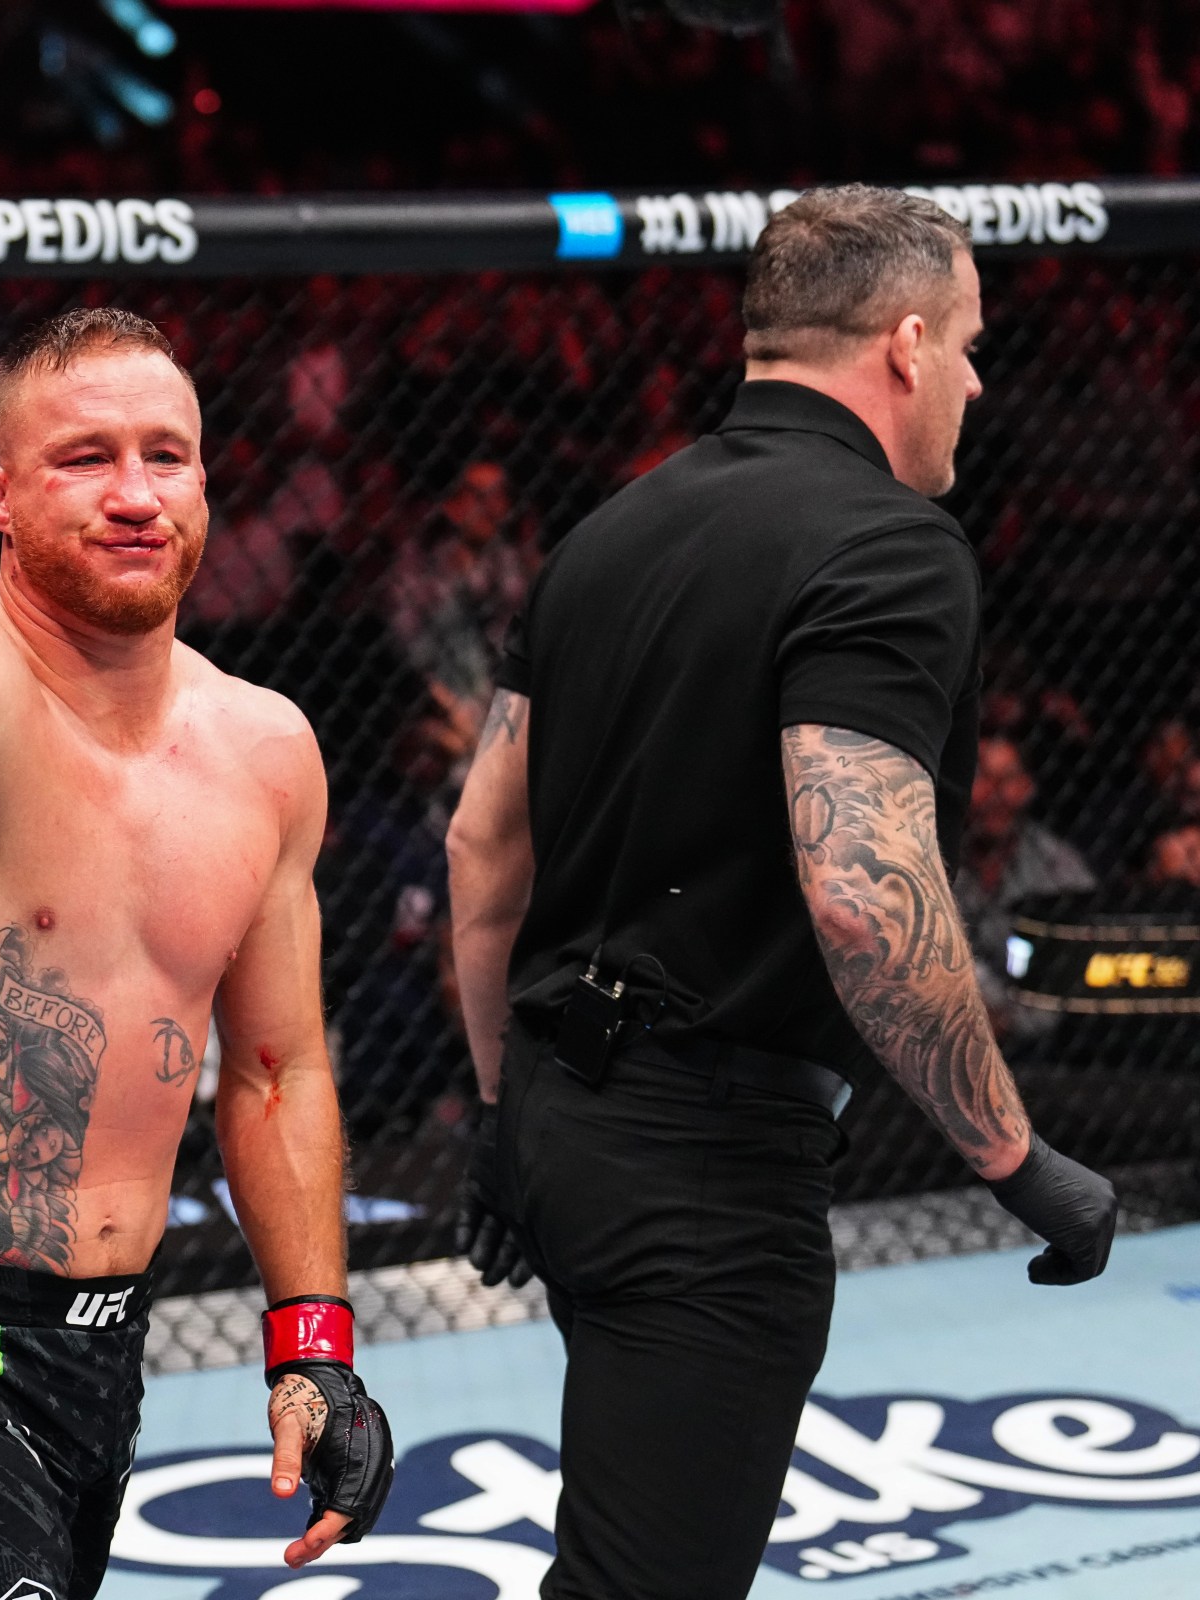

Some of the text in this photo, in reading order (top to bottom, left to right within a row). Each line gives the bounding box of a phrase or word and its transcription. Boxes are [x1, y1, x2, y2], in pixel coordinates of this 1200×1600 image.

[637, 192, 705, 253] #1
[704, 190, 767, 252] IN
[3, 986, 101, 1054] BEFORE
[65, 1285, 136, 1327] UFC
[281, 1381, 307, 1403] UFC
